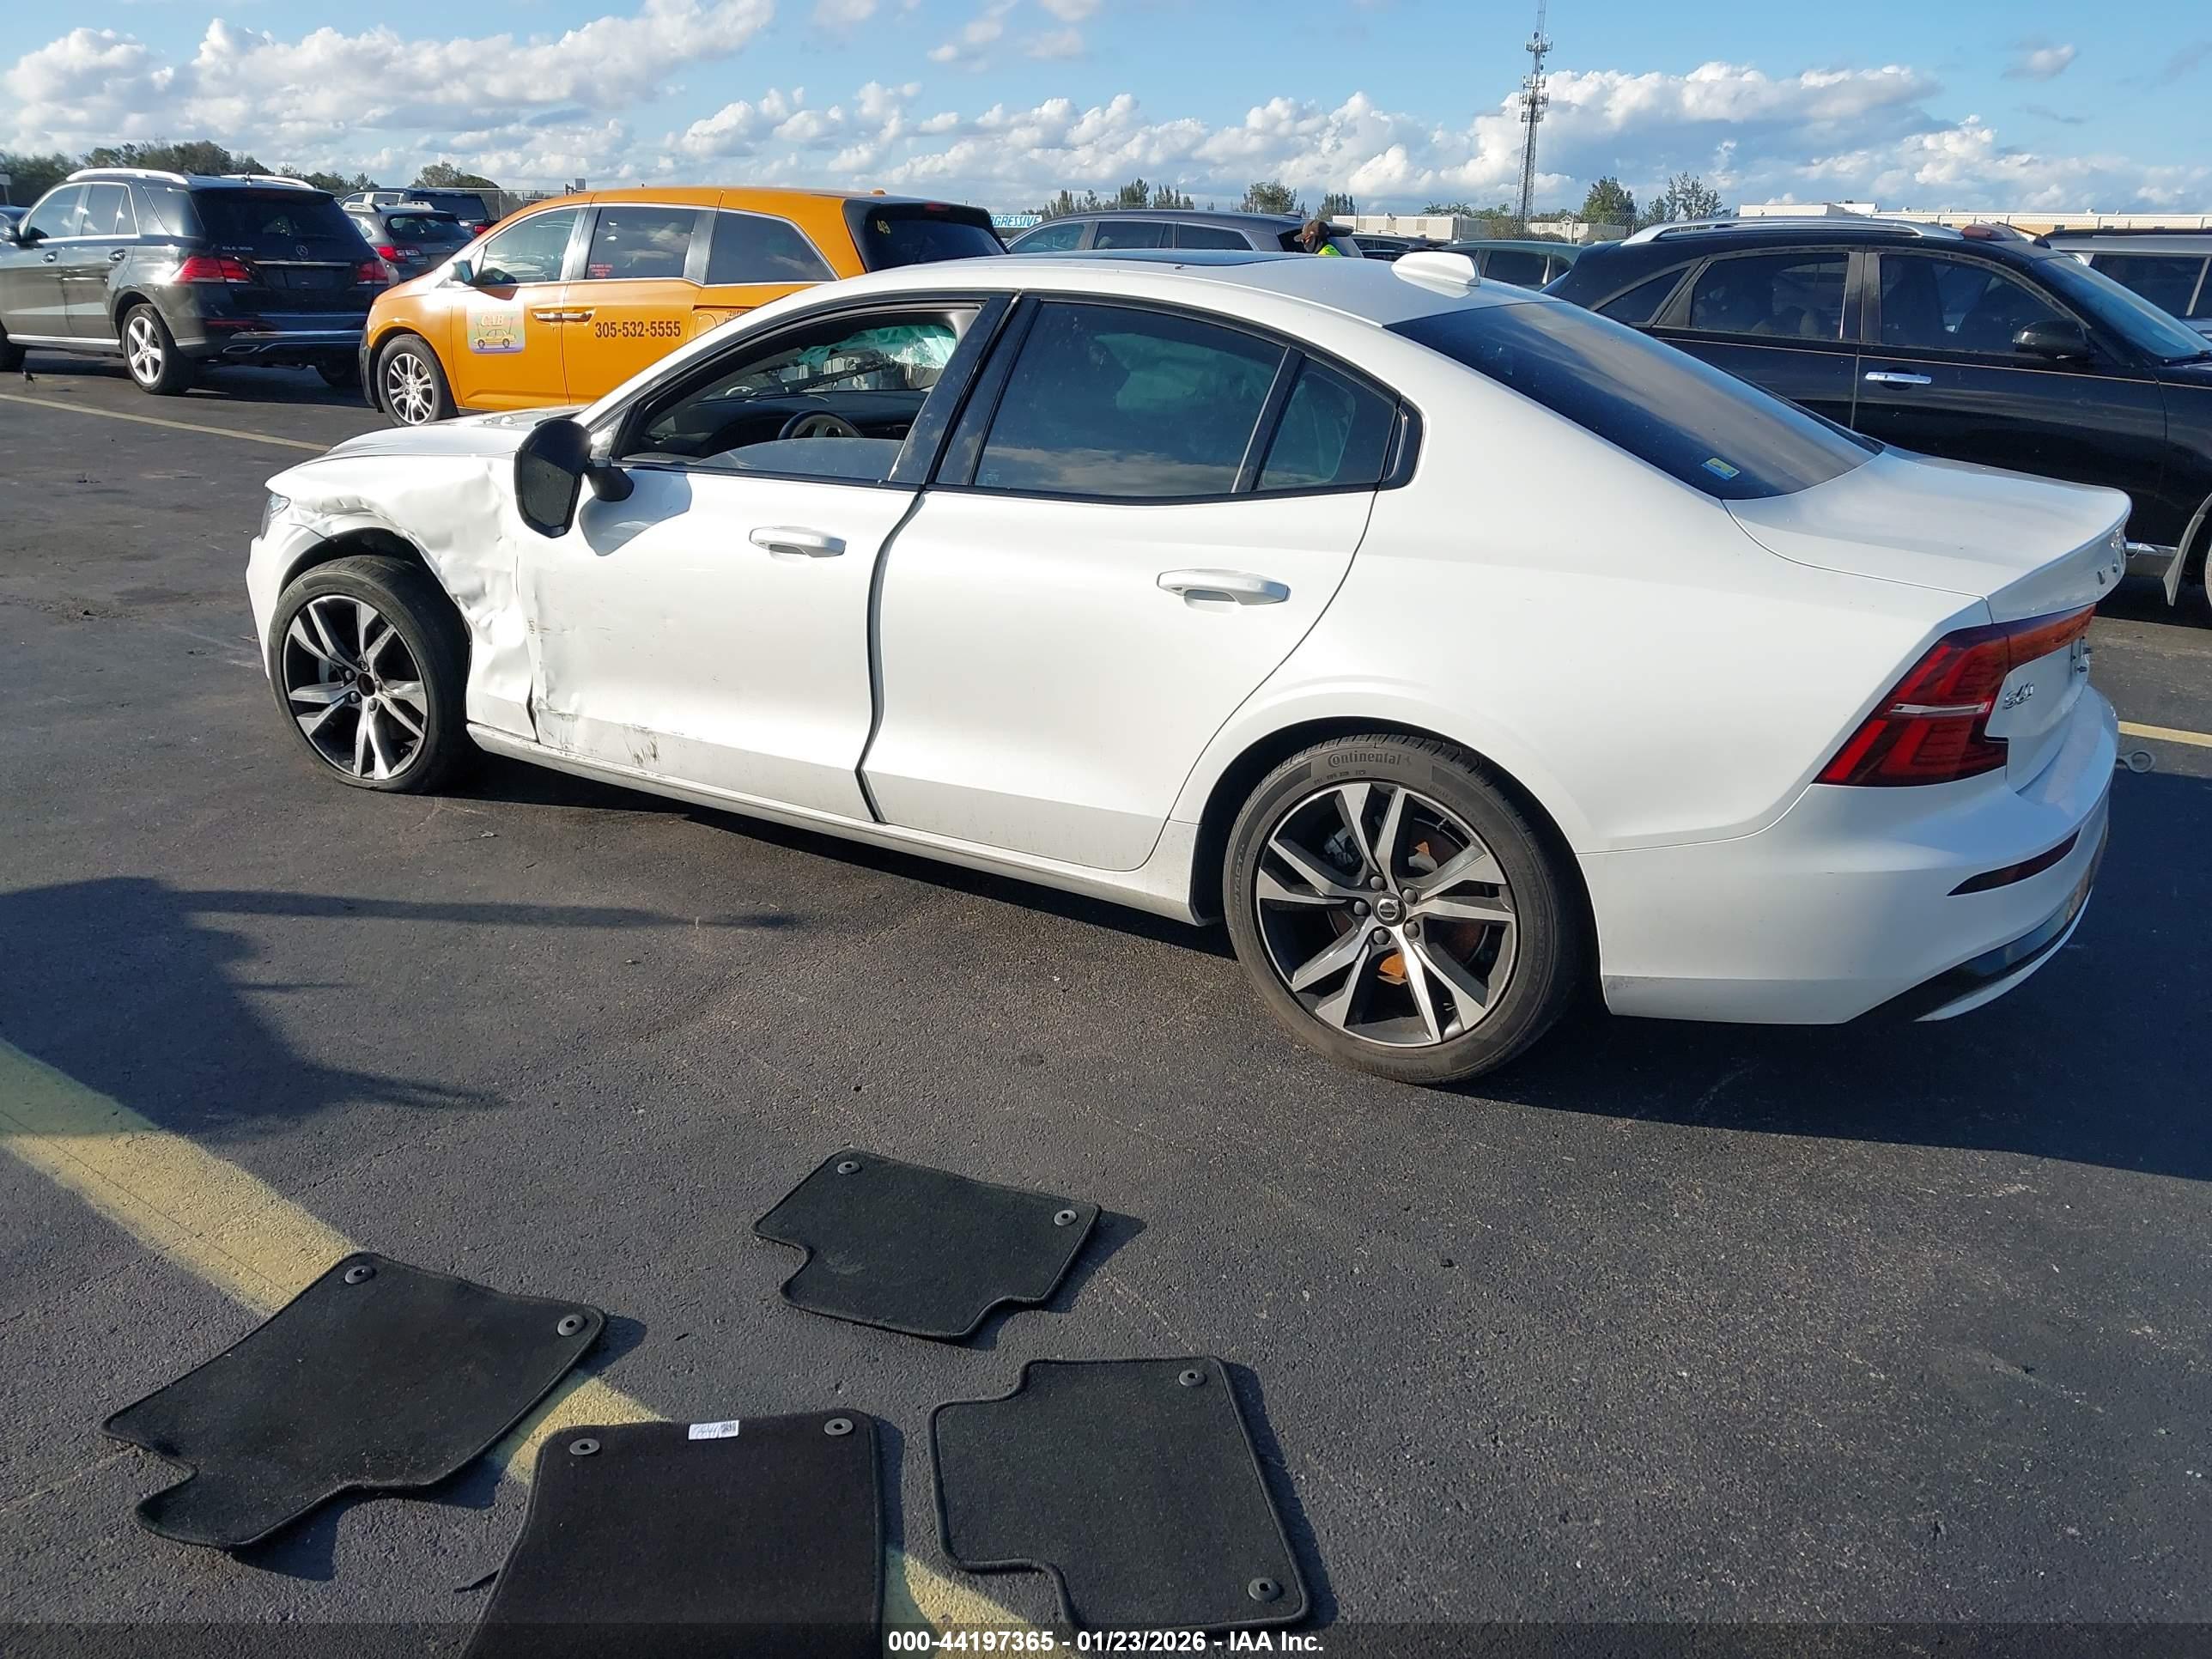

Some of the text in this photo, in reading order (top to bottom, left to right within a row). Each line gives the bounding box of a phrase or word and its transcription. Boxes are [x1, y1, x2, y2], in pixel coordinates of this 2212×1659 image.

[877, 219, 890, 234] 49
[481, 314, 504, 327] CAB
[595, 321, 681, 337] 305-532-5555
[1328, 750, 1401, 768] Continental
